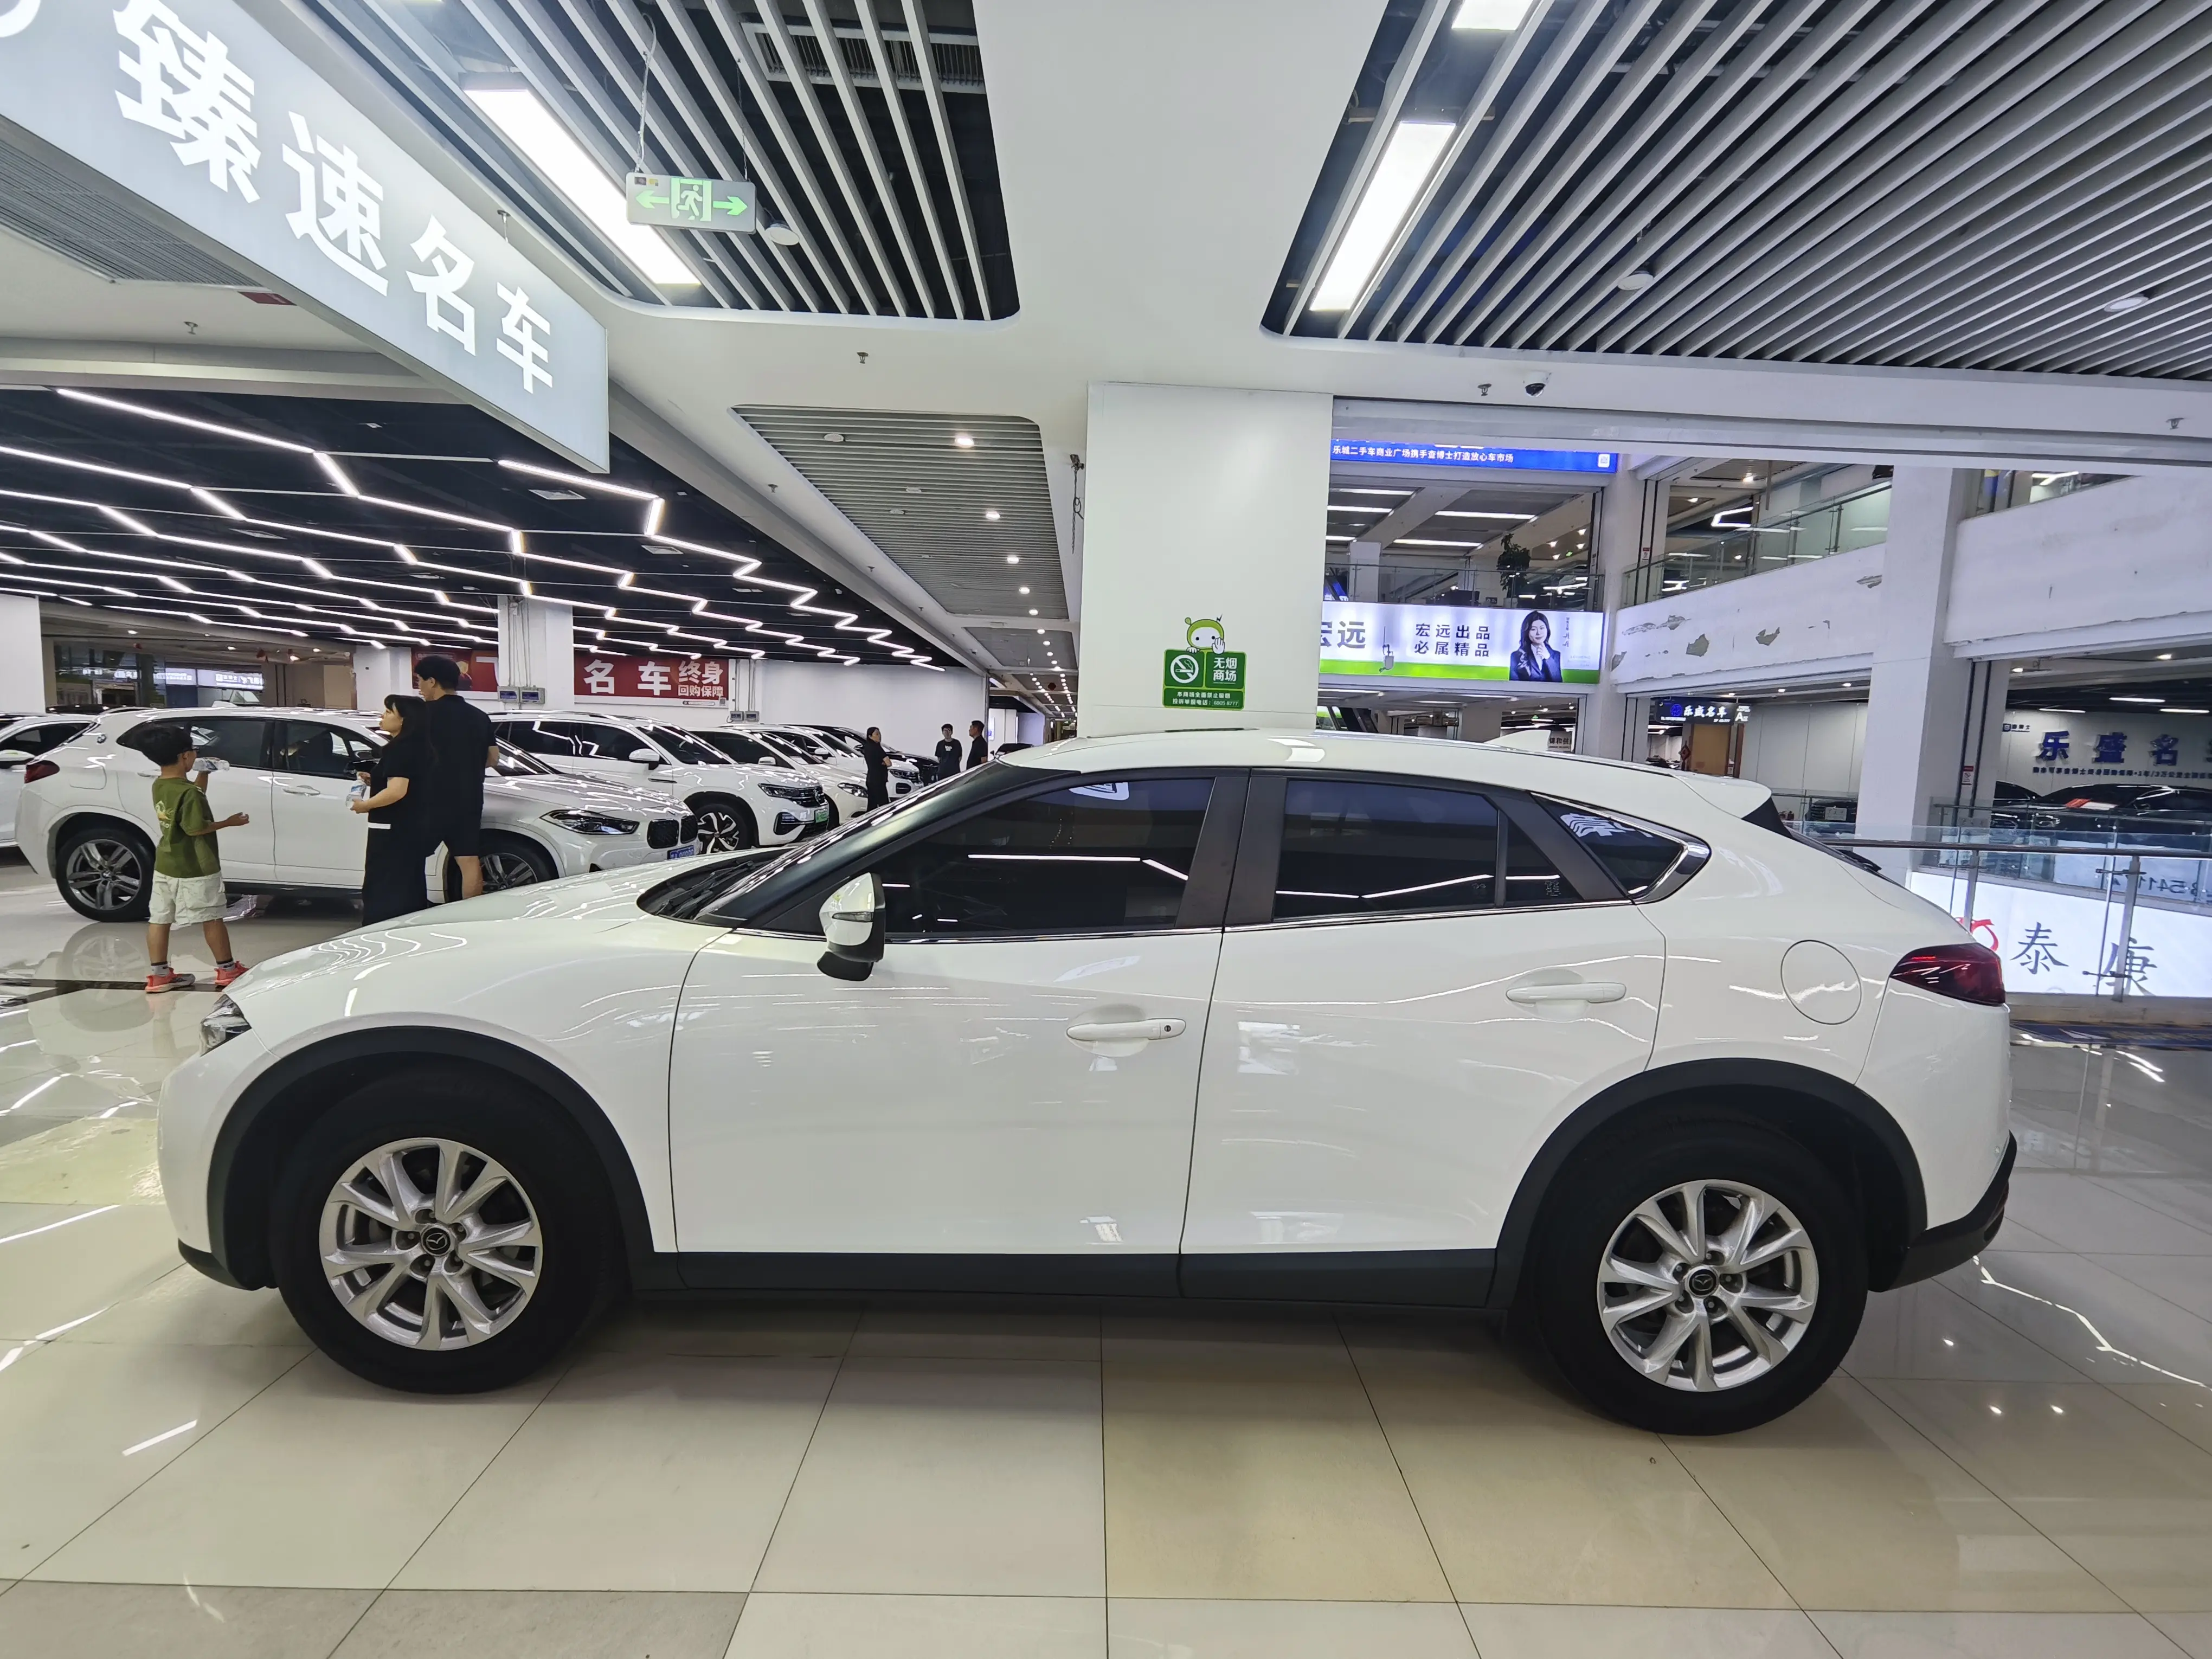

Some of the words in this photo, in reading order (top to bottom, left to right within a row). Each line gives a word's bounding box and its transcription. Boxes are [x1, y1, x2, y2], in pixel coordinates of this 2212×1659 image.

[111, 0, 553, 395] 臻速名车
[1416, 622, 1490, 640] 宏远出品
[1414, 640, 1490, 657] 必属精品
[1213, 657, 1237, 669] 无烟
[678, 660, 724, 685] 终身
[1213, 669, 1237, 681] 商场
[678, 684, 724, 697] 回购保障
[2035, 730, 2212, 767] 乐盛名
